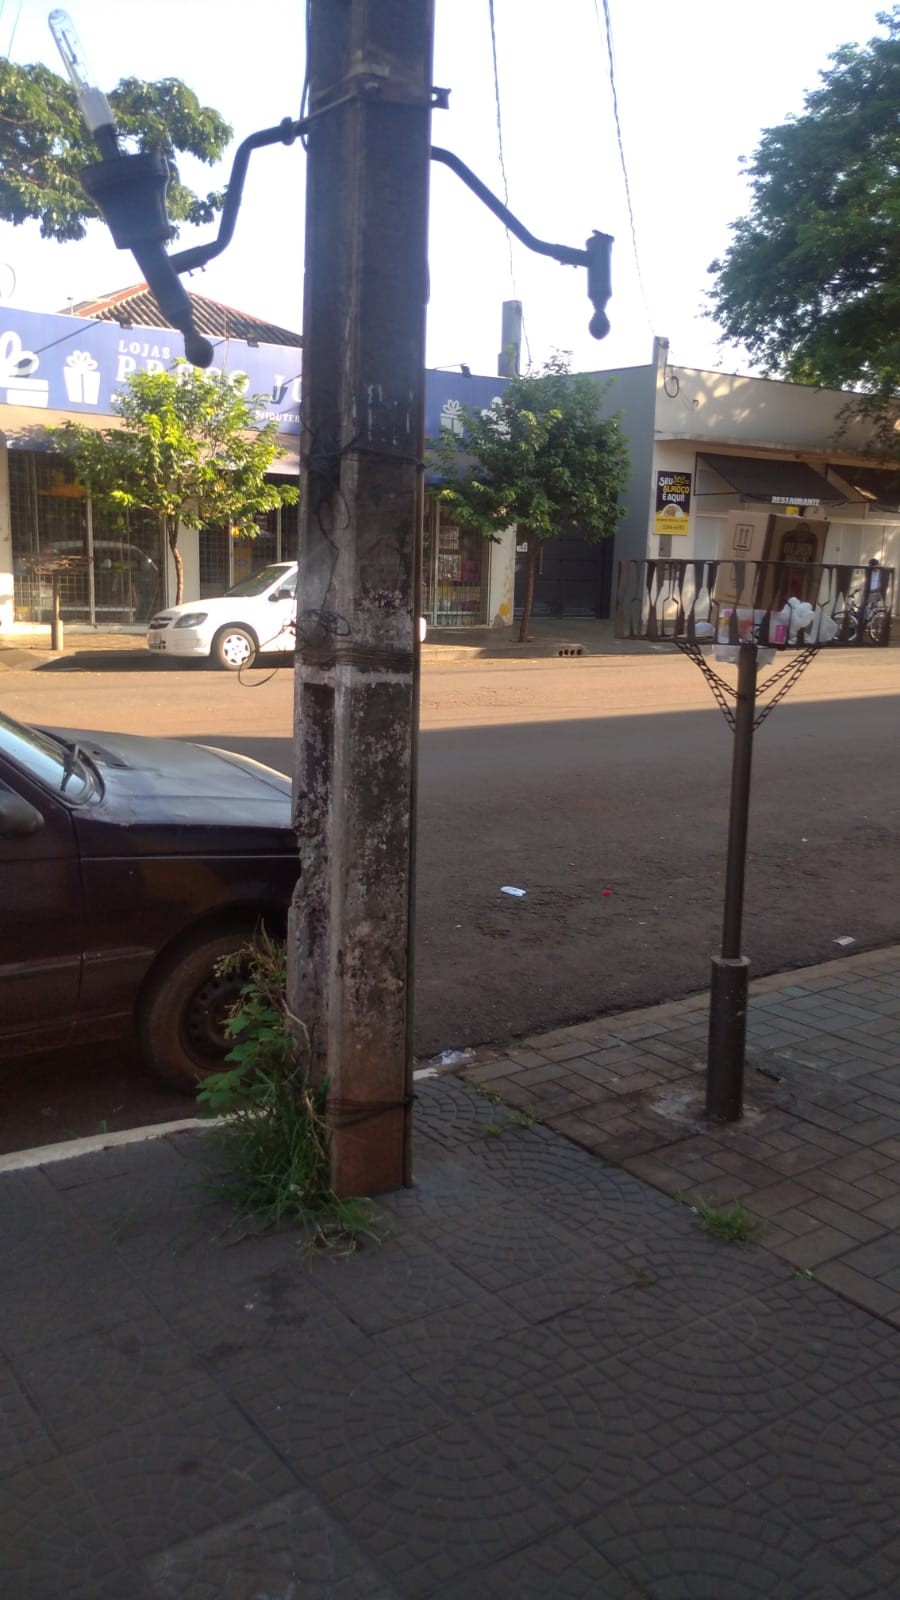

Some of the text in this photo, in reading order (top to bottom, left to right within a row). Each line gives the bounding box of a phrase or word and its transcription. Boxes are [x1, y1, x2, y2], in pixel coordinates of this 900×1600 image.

[118, 340, 171, 359] LOJAS
[659, 476, 674, 487] SEU
[771, 496, 820, 507] RESTAURANTE
